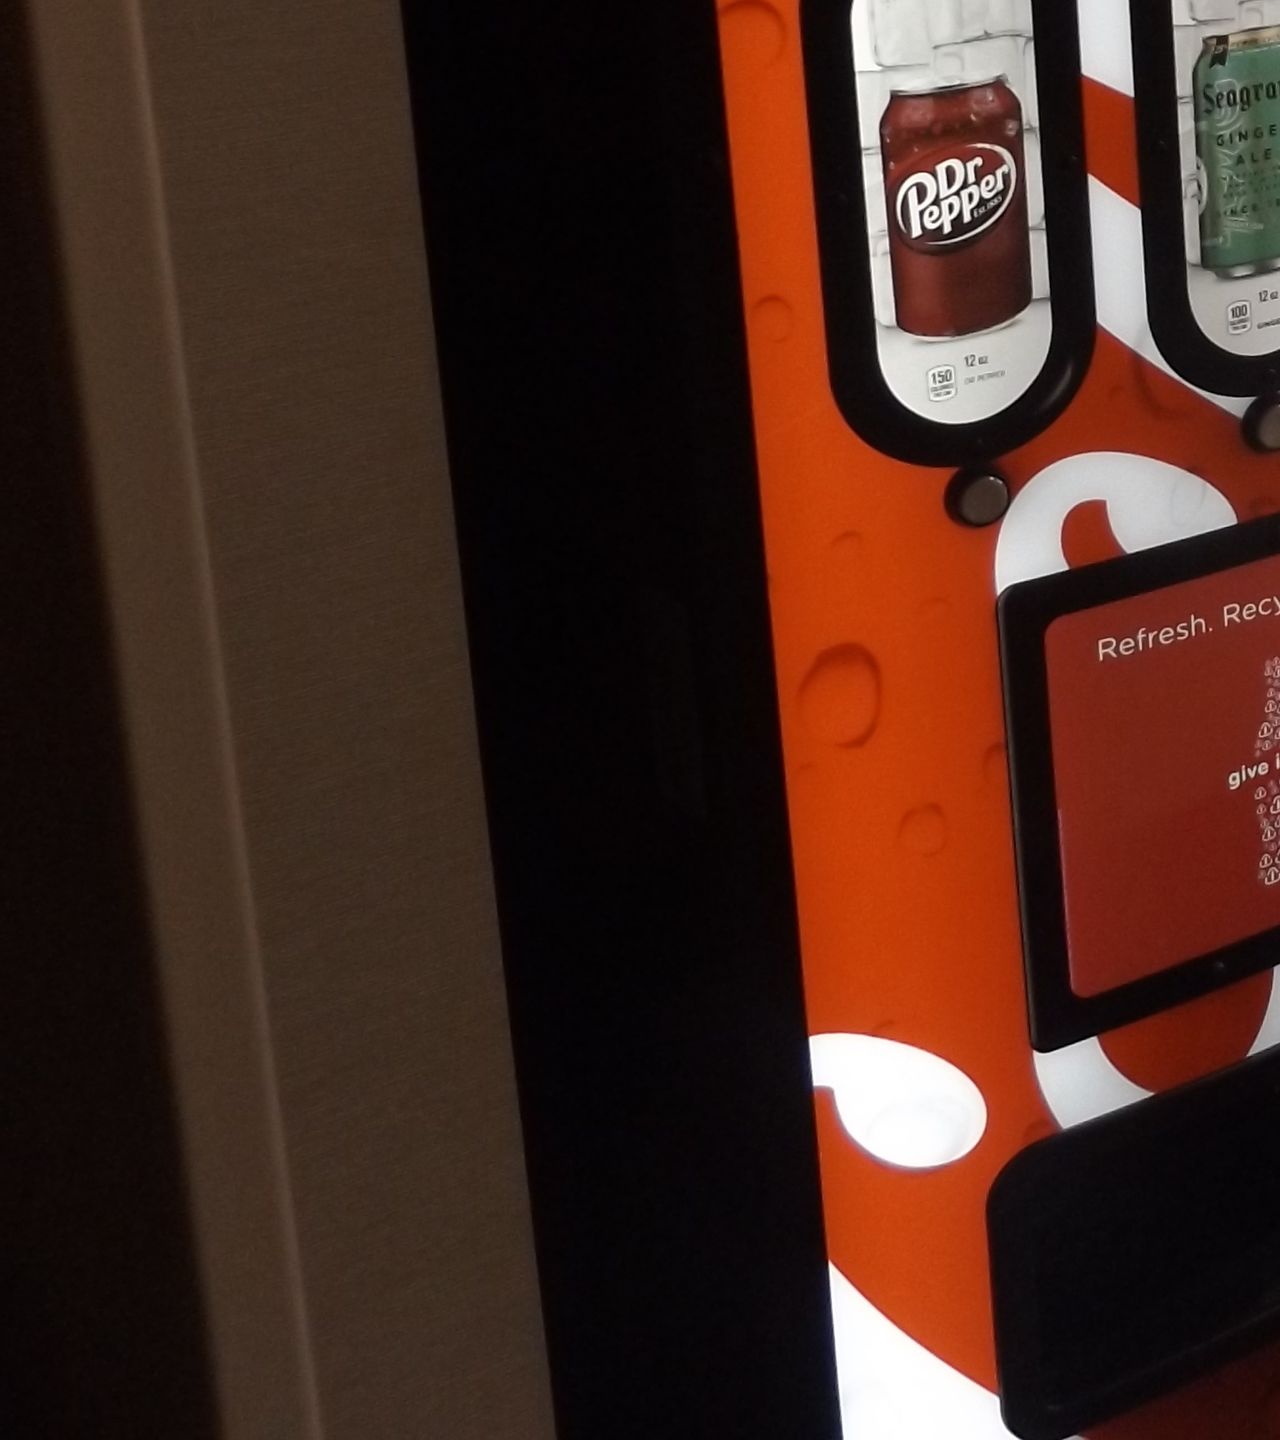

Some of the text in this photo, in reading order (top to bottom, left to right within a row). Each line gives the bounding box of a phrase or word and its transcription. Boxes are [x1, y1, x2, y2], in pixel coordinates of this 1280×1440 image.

[1236, 148, 1272, 166] ALE
[935, 156, 983, 200] Dr
[896, 163, 1009, 240] Pepper
[1258, 290, 1269, 302] 12
[1230, 304, 1248, 319] 100
[964, 353, 976, 367] 12
[931, 368, 953, 385] 150
[1097, 614, 1213, 662] Refresh.
[1228, 764, 1269, 790] give
